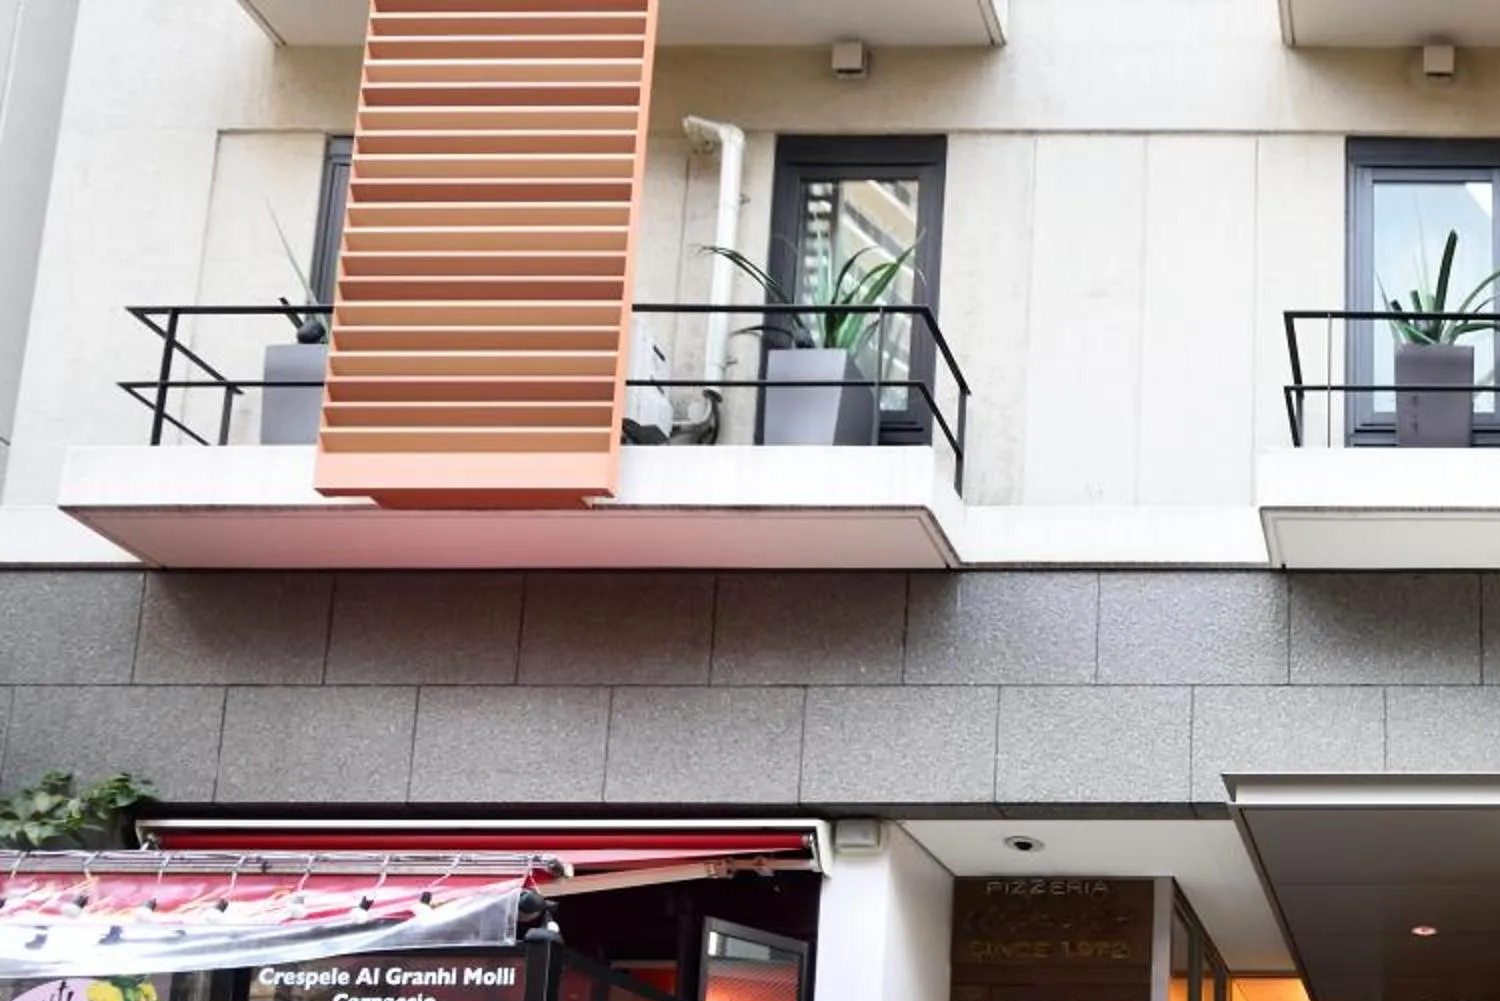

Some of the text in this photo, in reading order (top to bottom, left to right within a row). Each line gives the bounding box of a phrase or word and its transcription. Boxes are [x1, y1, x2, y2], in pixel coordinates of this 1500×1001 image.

[986, 880, 1108, 896] PIZZERIA
[969, 940, 1053, 959] SINCE
[257, 966, 351, 990] Crespele
